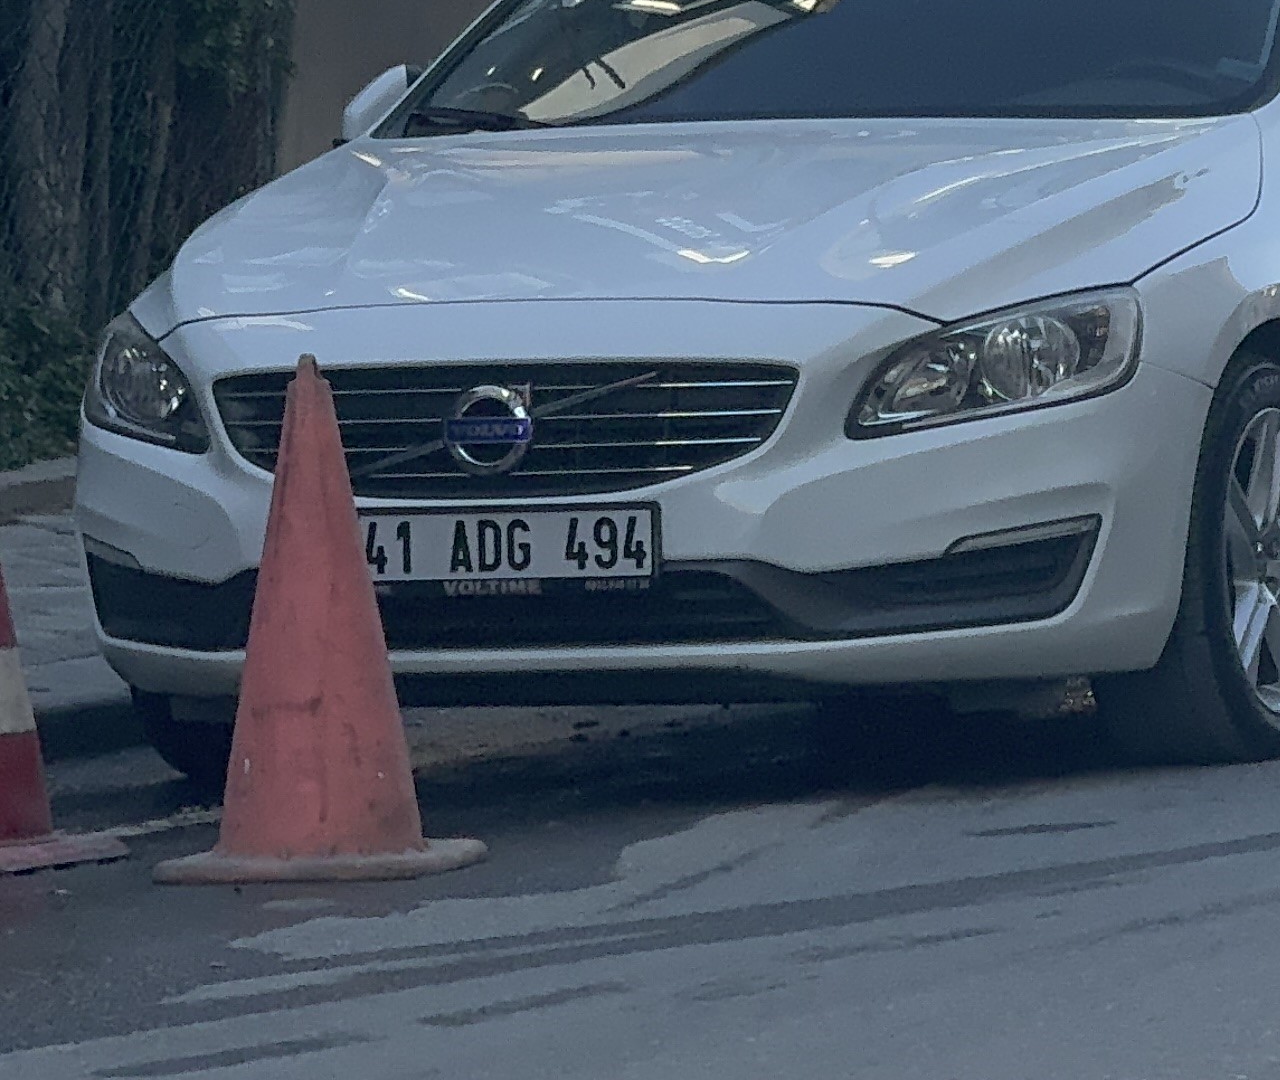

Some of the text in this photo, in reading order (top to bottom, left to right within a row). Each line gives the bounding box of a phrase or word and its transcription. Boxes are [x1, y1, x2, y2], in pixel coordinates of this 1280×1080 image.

[366, 516, 647, 574] 41 ADG 494
